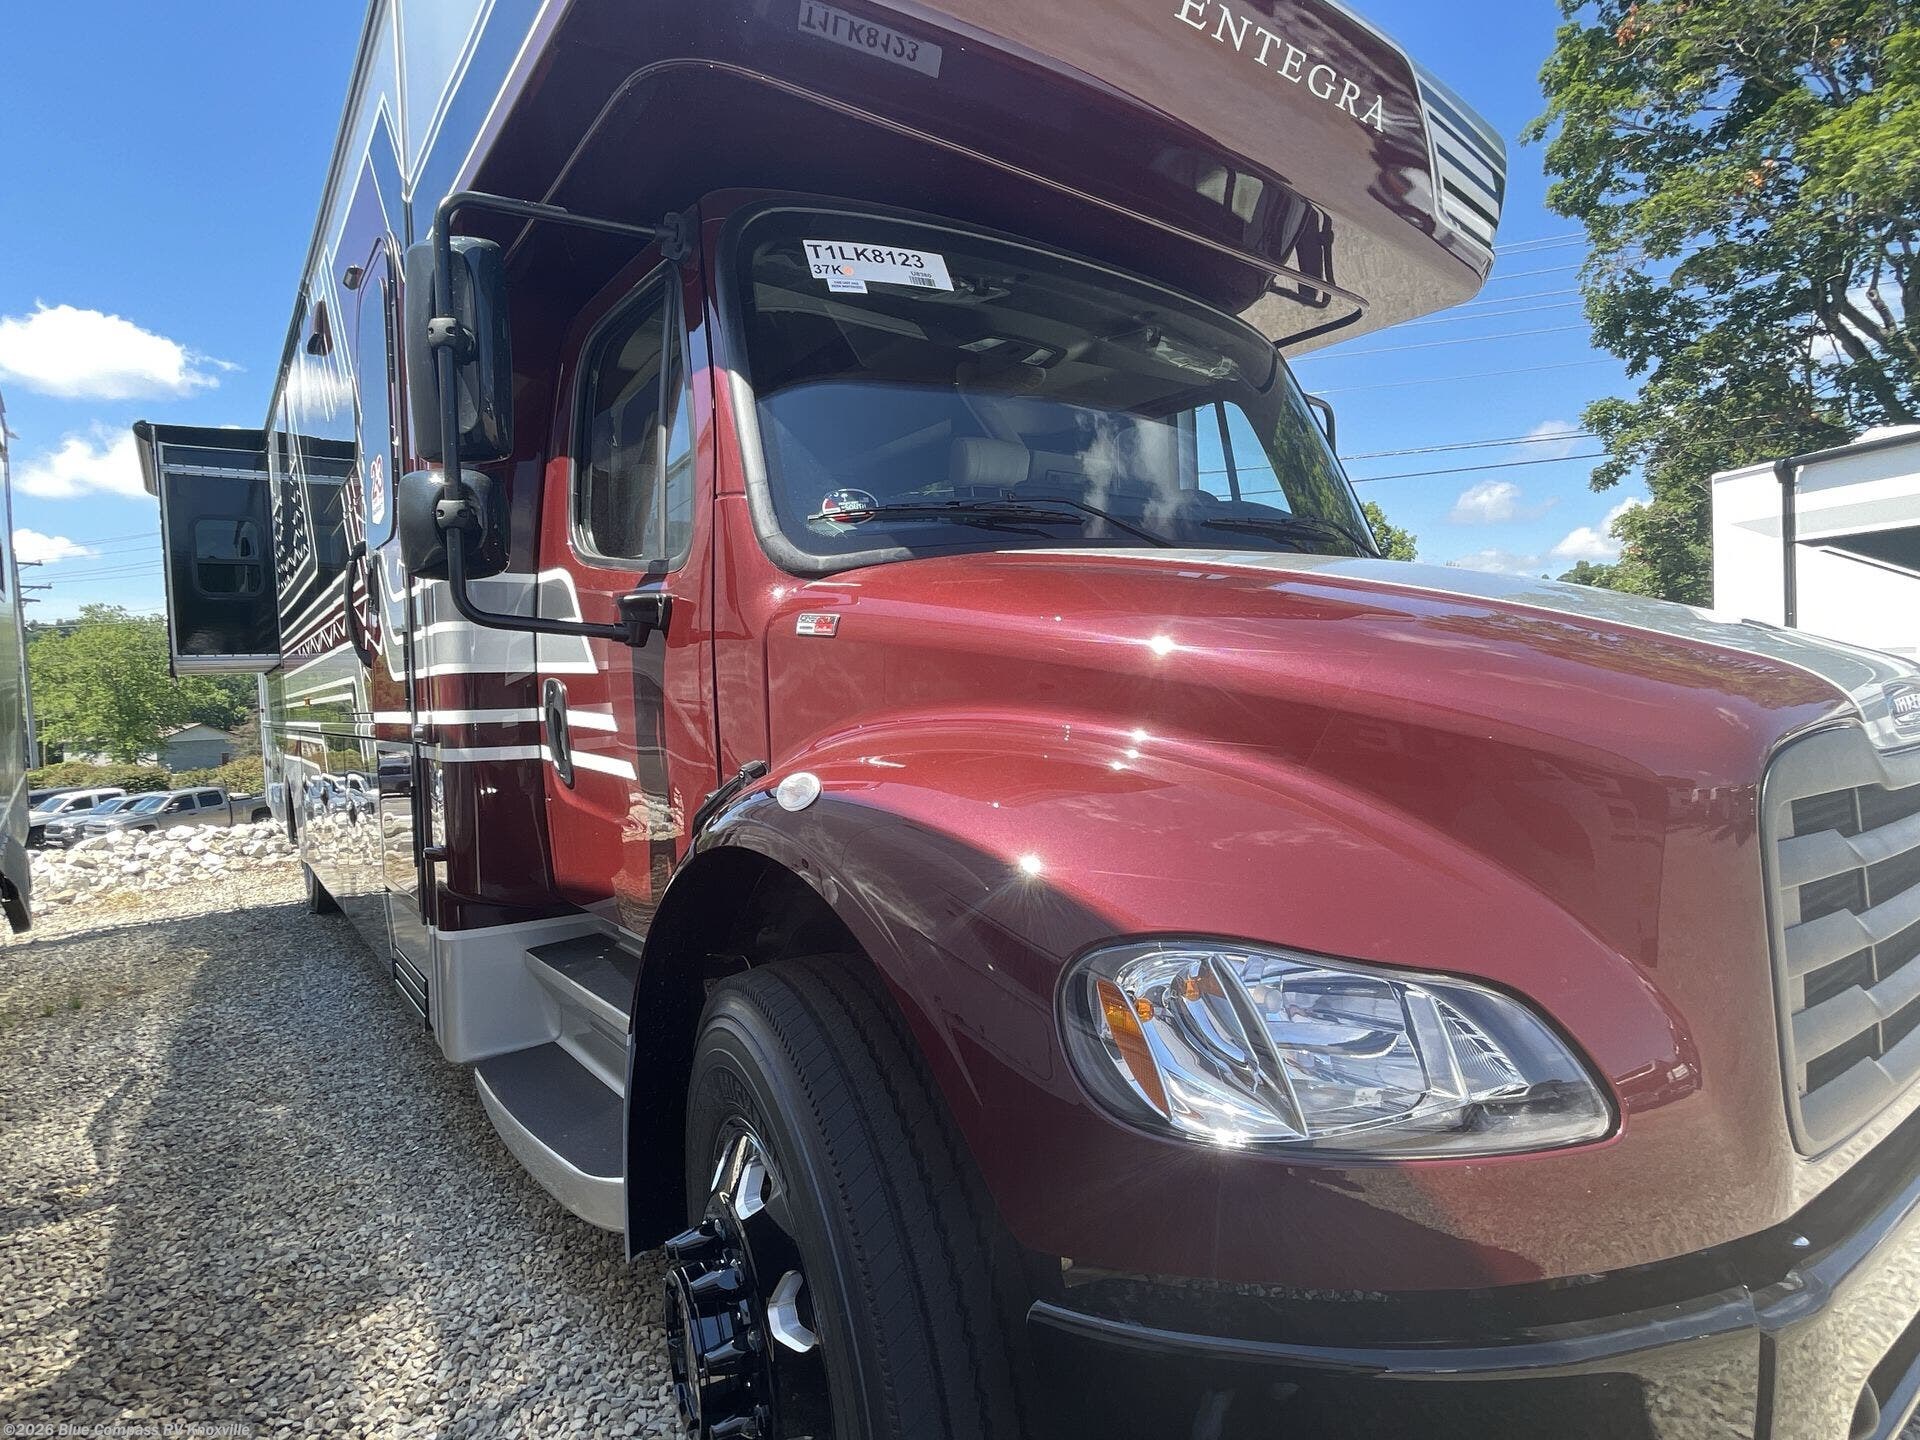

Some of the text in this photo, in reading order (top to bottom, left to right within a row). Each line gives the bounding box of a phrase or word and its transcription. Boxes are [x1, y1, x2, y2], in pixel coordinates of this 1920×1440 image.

[1174, 0, 1384, 133] ENTEGRA
[807, 244, 925, 269] T1LK8123
[813, 264, 844, 275] 37K
